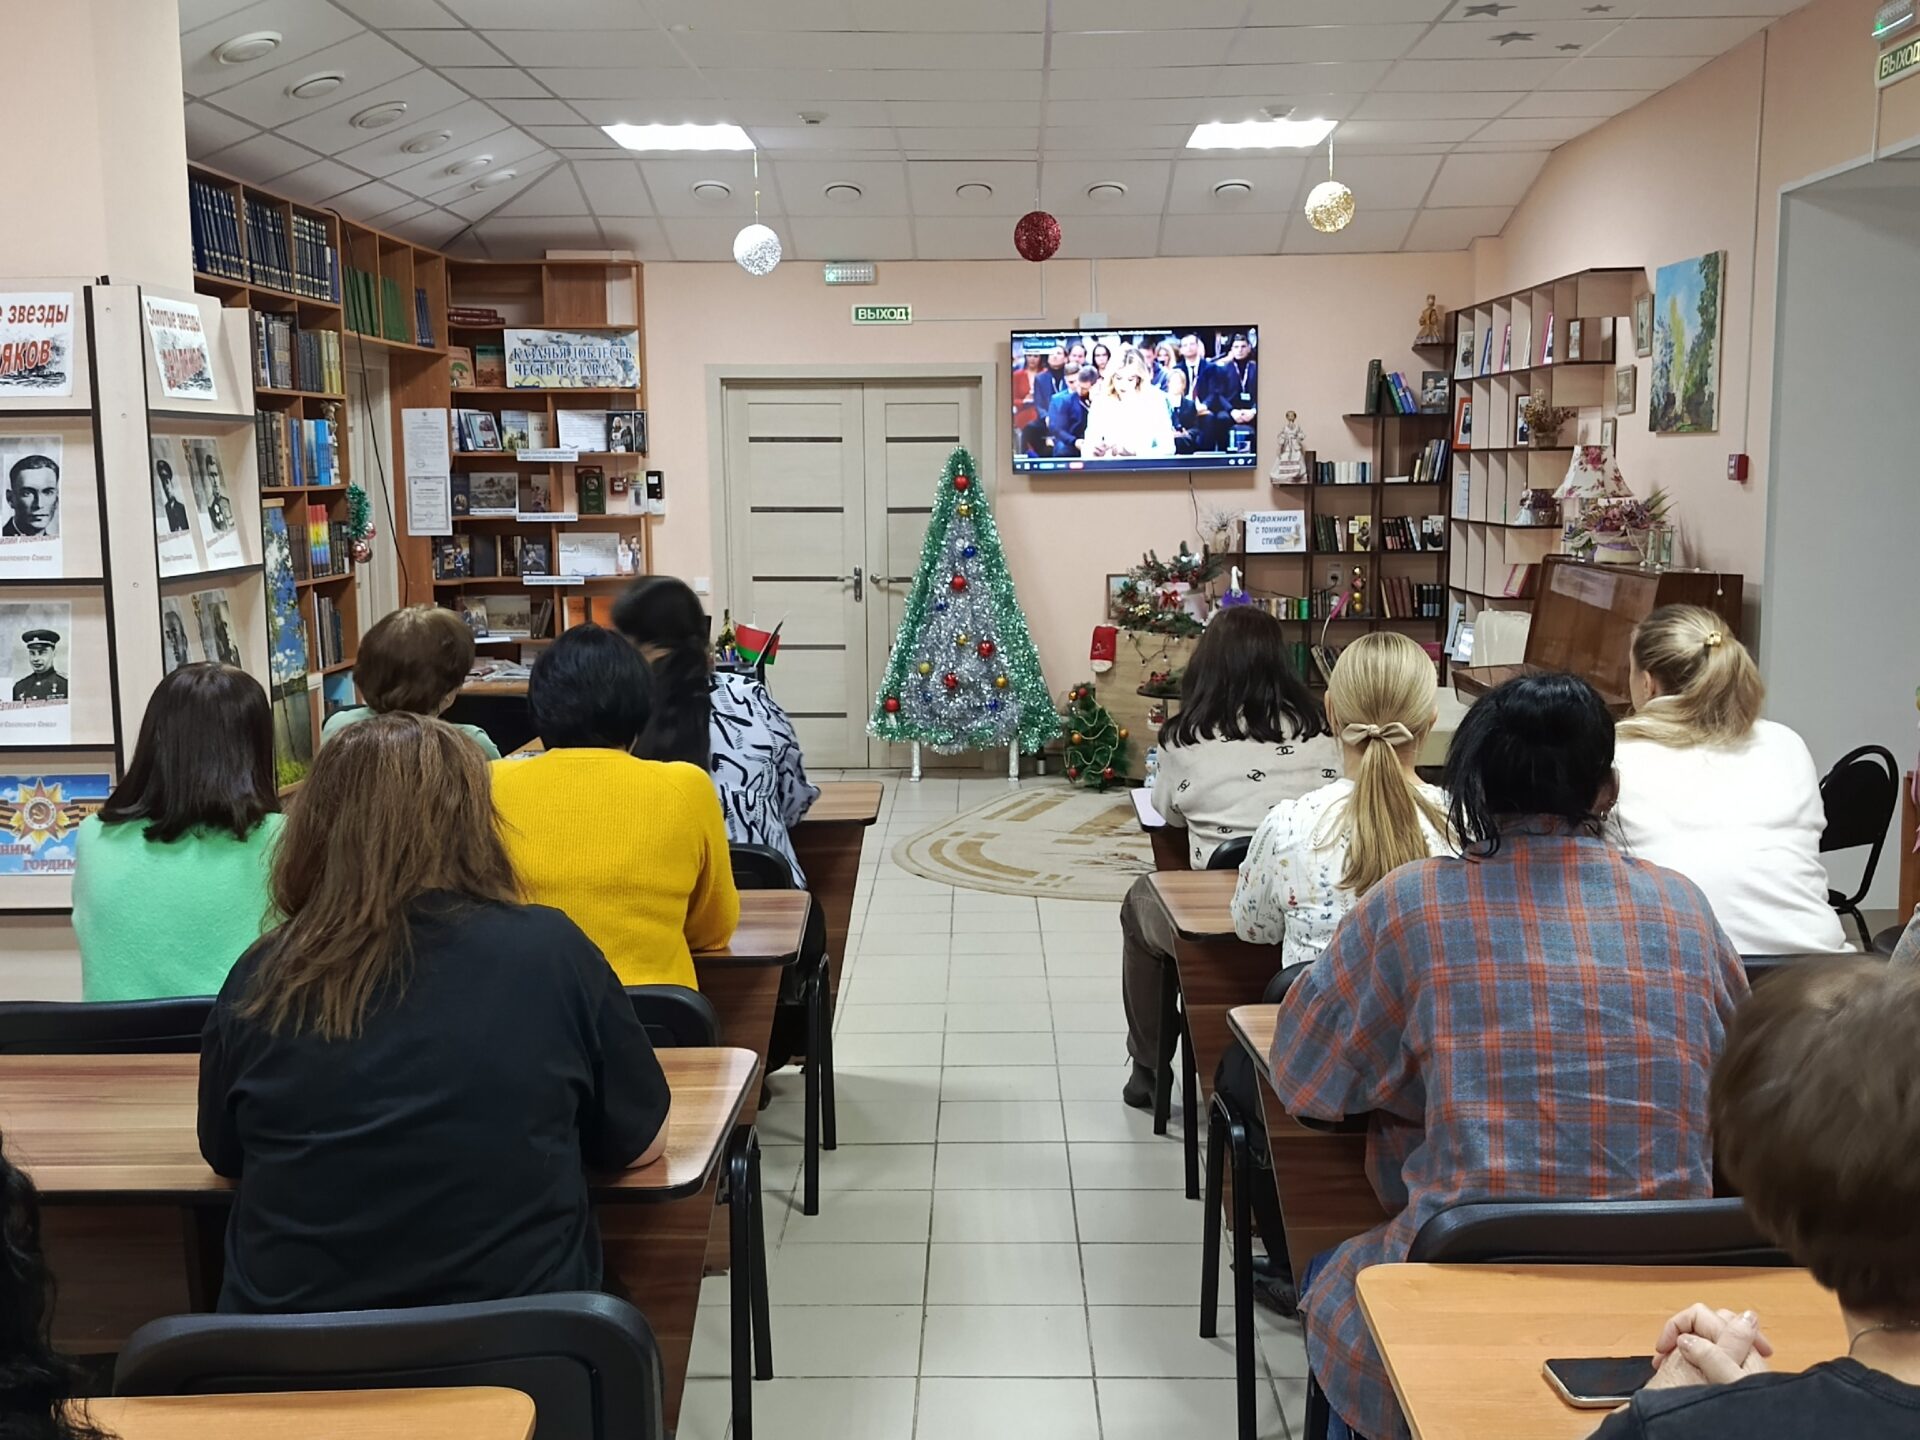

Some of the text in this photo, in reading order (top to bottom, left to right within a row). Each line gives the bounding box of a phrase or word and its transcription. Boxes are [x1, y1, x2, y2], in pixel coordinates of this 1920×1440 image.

[1881, 41, 1920, 77] ВЫХОД
[8, 304, 69, 328] звезды
[858, 308, 907, 320] ВЫХОД
[514, 363, 553, 376] ЧЕСТЬ
[556, 363, 564, 376] И
